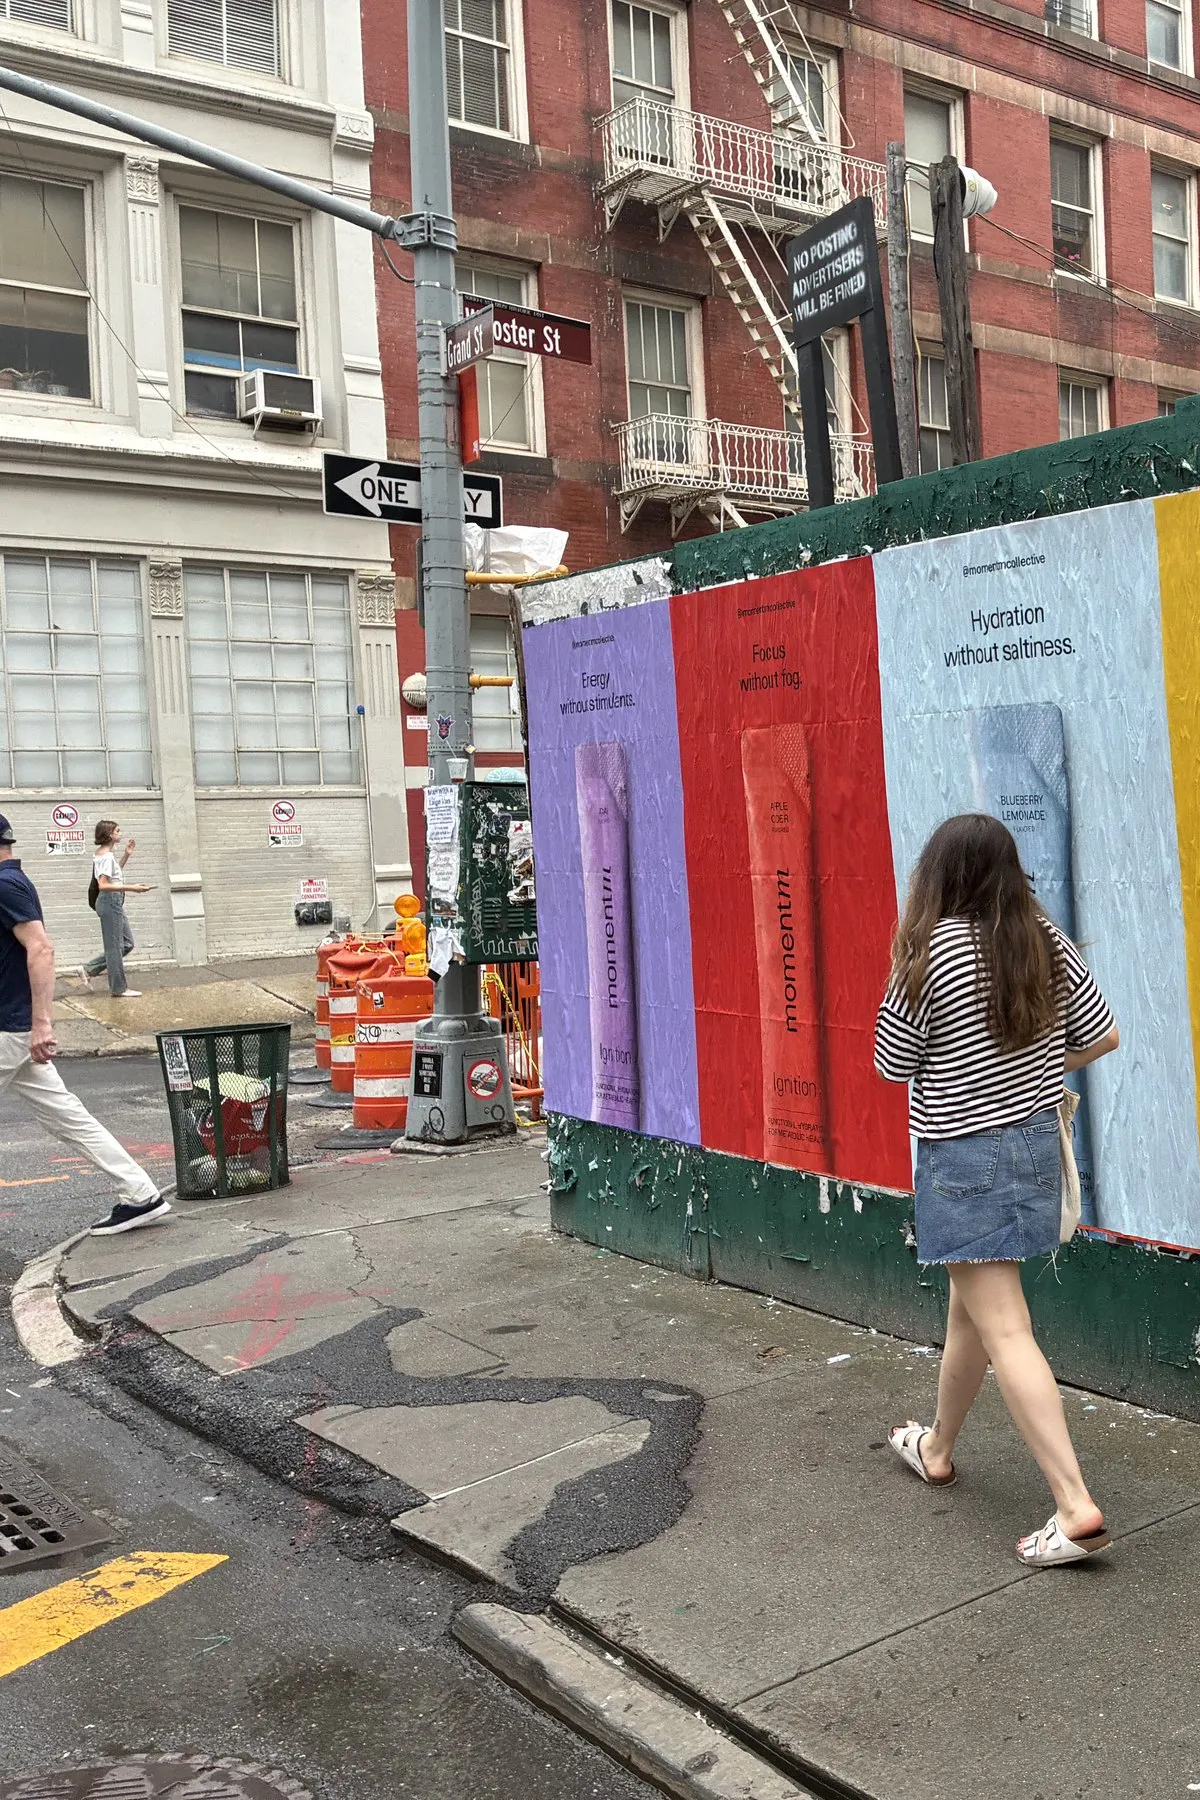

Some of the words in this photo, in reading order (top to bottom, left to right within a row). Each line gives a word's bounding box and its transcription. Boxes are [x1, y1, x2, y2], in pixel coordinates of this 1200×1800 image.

[793, 250, 809, 274] NO
[809, 221, 858, 264] POSTING
[792, 244, 864, 300] ADVERTISERS
[793, 297, 819, 322] WILL
[819, 288, 834, 312] BE
[834, 270, 866, 303] FINED
[447, 332, 473, 368] Grand
[474, 324, 485, 353] St
[543, 325, 562, 355] St
[361, 477, 409, 504] ONE
[971, 604, 1044, 635] Hydration
[753, 644, 786, 663] Focus
[944, 642, 999, 667] without
[1003, 636, 1076, 661] saltiness.
[740, 672, 779, 692] without
[781, 668, 802, 690] fog.
[1000, 795, 1044, 805] BLUEBERRY
[270, 826, 301, 835] WARNING
[1002, 810, 1046, 821] LEMONADE
[776, 868, 798, 1033] momentm
[773, 1072, 816, 1097] Ignition
